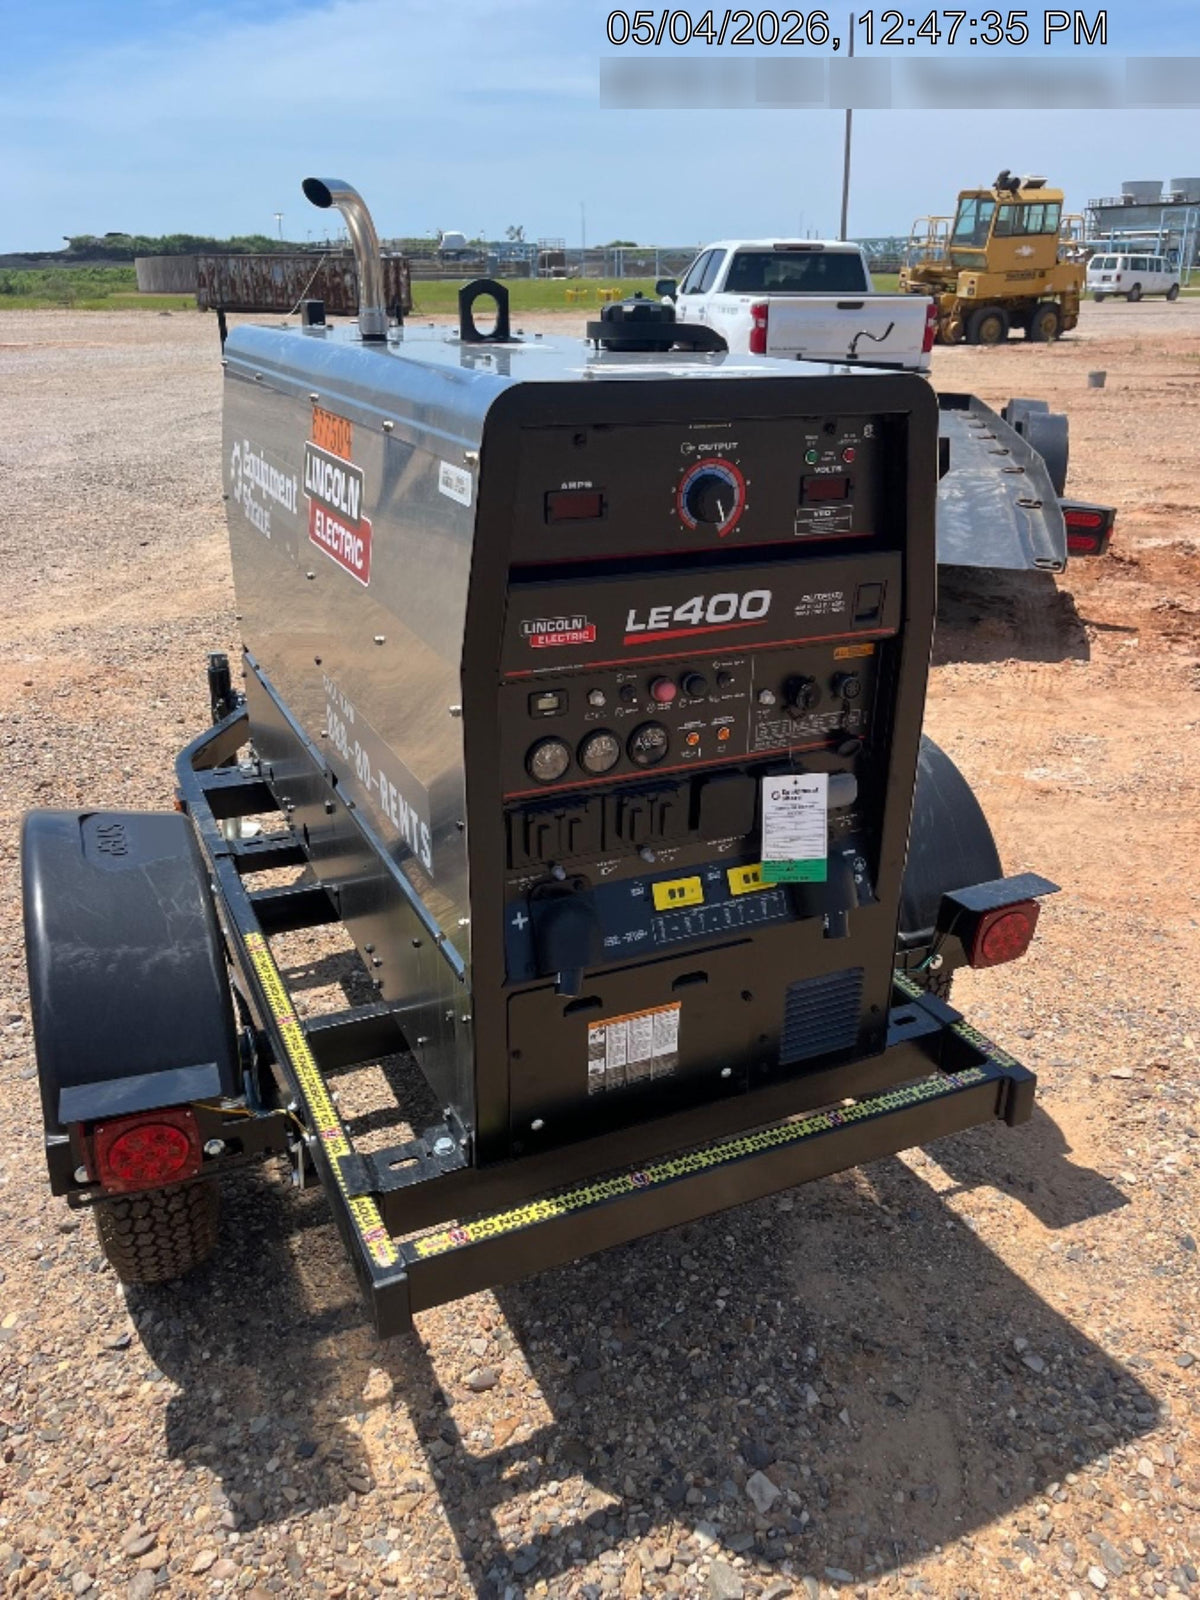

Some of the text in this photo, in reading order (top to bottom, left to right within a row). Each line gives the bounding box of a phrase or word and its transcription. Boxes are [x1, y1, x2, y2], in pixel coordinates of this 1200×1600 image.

[698, 442, 739, 452] OUTPUT
[304, 452, 360, 520] LINCOLN
[315, 509, 364, 570] ELECTRIC
[523, 617, 583, 634] LINCOLN
[625, 589, 772, 632] LE400
[537, 629, 590, 645] ELECTRIC
[470, 1222, 495, 1236] DO
[498, 1210, 532, 1226] NOT
[534, 1193, 587, 1216] STAND
